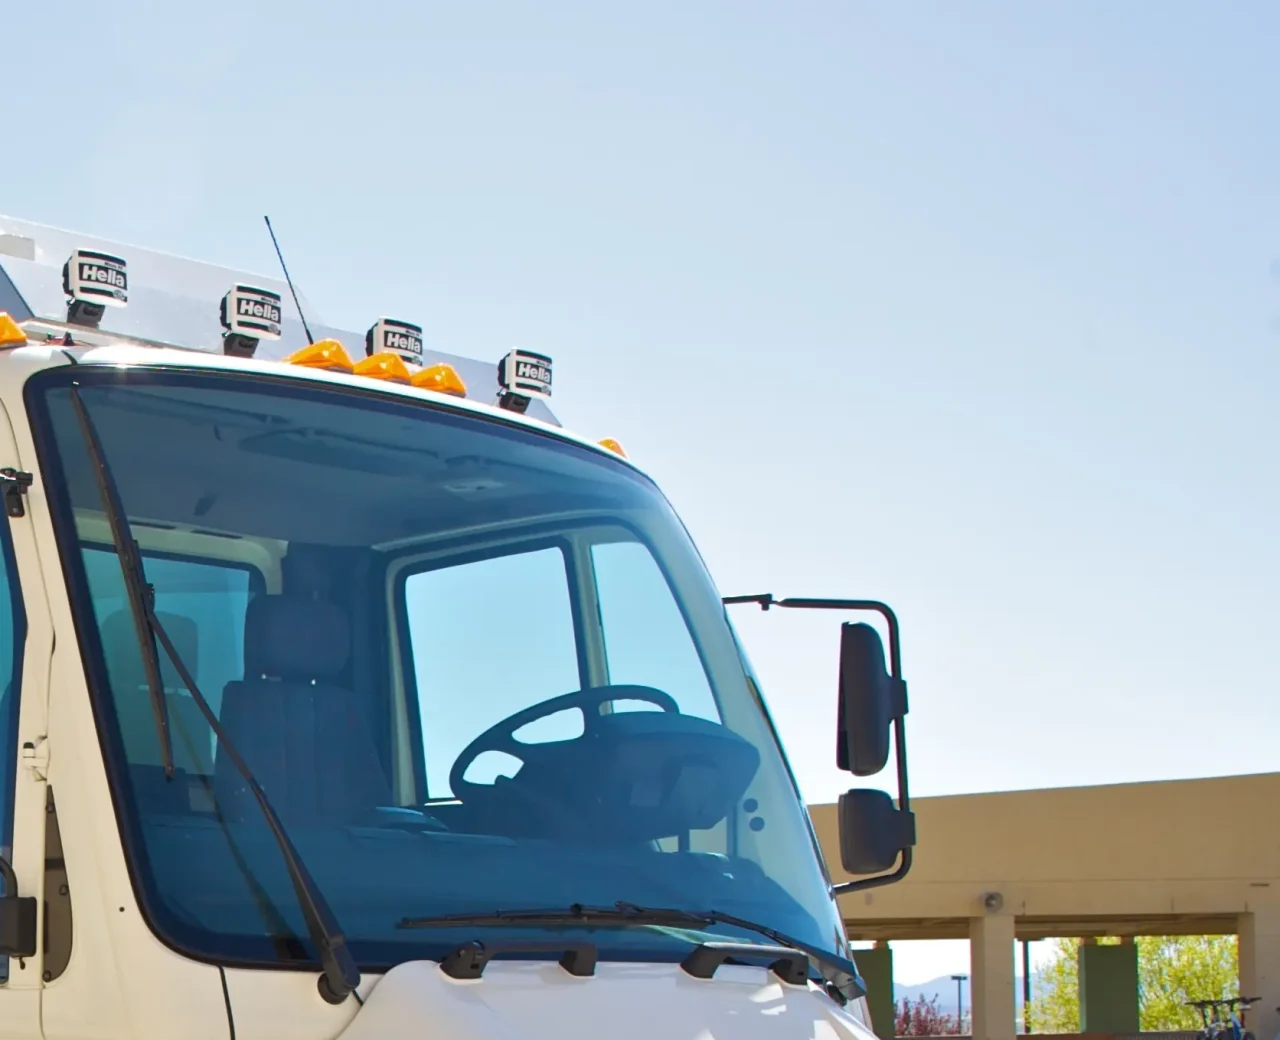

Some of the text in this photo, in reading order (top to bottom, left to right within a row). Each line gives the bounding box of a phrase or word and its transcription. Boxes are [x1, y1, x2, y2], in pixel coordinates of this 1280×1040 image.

[82, 264, 125, 288] Hella
[240, 299, 279, 322] Hella
[386, 332, 421, 353] Hella
[518, 362, 551, 383] Hella
